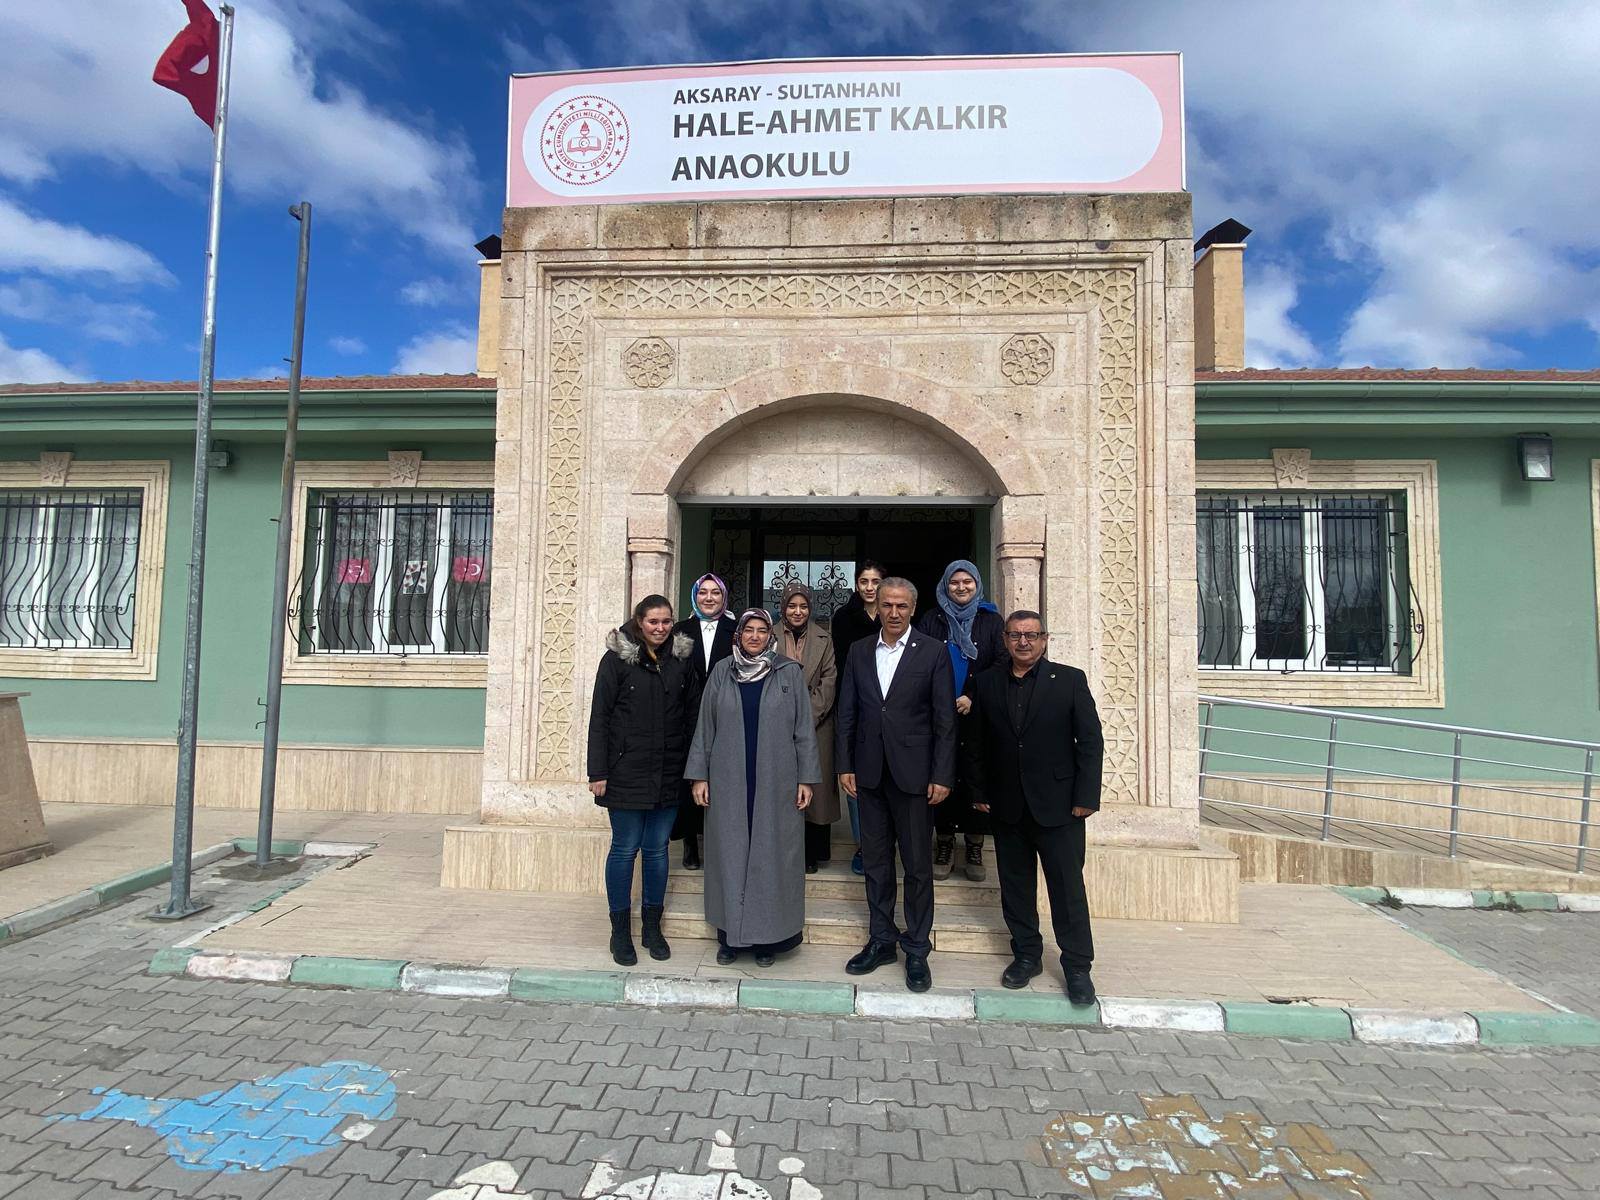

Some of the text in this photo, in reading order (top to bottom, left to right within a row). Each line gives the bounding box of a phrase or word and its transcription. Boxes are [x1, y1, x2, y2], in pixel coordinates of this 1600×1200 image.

[673, 85, 762, 104] AKSARAY
[777, 82, 901, 101] SULTANHANI
[673, 104, 1008, 138] HALE-AHMET KALKIR
[671, 150, 850, 181] ANAOKULU
